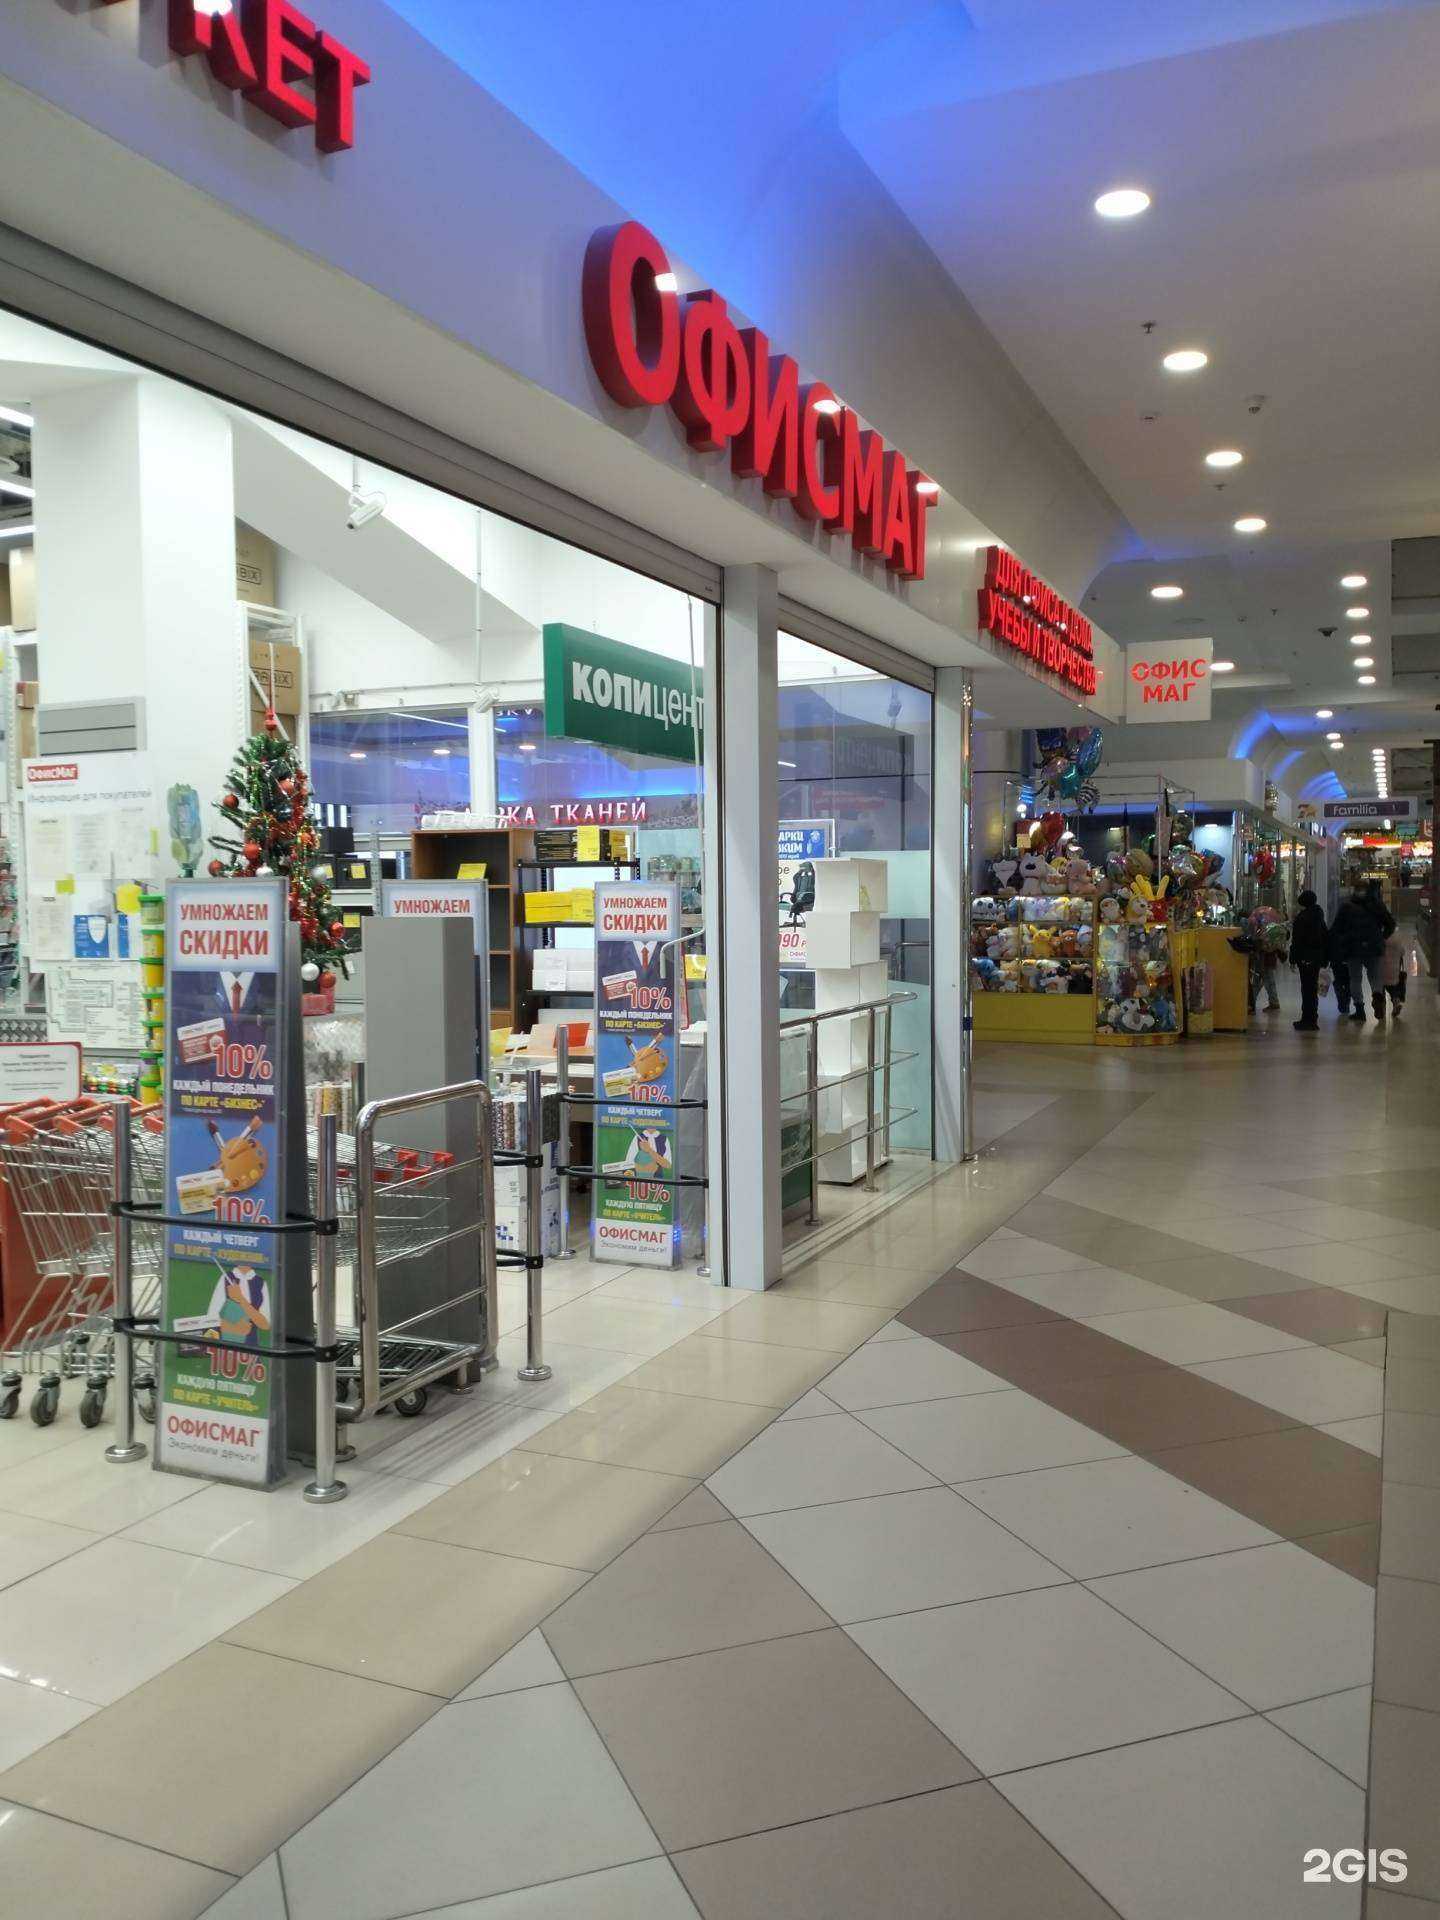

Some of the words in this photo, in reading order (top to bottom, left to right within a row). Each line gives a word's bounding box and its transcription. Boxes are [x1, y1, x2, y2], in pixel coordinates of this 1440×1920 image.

[582, 221, 940, 580] ОФИСМАГ
[990, 548, 1021, 598] ДЛЯ
[1021, 568, 1059, 624] ОФИСА
[981, 589, 1030, 650] УЧЕБЫ
[1041, 627, 1096, 696] ТВОРЧЕСТВА
[1131, 658, 1207, 682] ОФИС
[1143, 682, 1196, 703] МАГ
[550, 797, 648, 822] ТКАНЕЙ
[180, 904, 268, 921] УМНОЖАЕМ
[393, 899, 471, 914] УМНОЖАЕМ
[603, 897, 667, 909] УМНОЖАЕМ
[603, 914, 668, 934] СКИДКИ
[180, 930, 269, 960] СКИДКИ
[629, 986, 672, 1010] 10%
[215, 1043, 273, 1080] 10%
[599, 1226, 667, 1244] ОФИСМАГ
[167, 1415, 260, 1447] ОФИСМАГ
